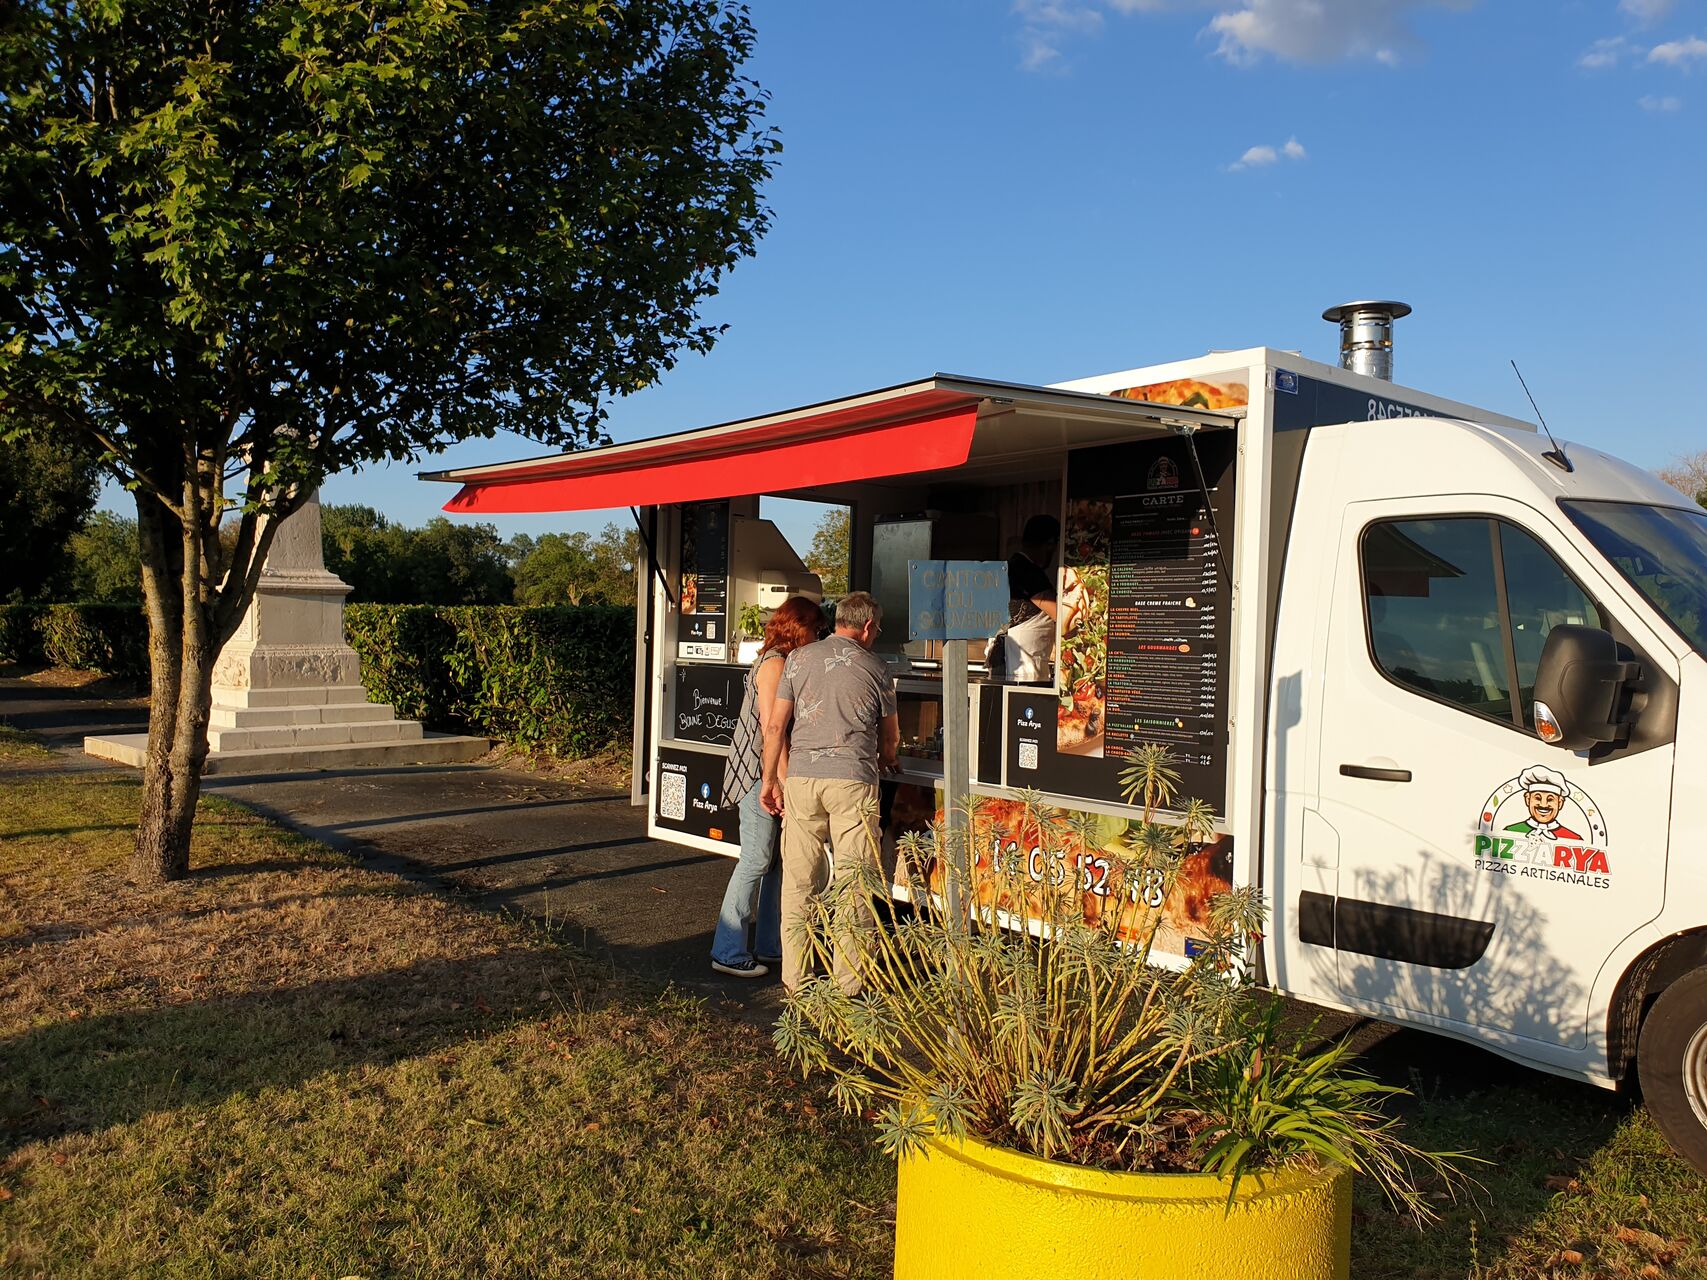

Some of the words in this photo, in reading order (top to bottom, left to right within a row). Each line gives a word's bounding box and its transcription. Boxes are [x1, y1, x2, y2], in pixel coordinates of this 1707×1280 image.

[1142, 495, 1184, 506] CARTE
[923, 570, 1000, 590] CANTON
[946, 592, 973, 608] DU
[920, 610, 1002, 630] SOUVENIR
[706, 712, 738, 730] DEGUS
[1028, 720, 1041, 730] Arya
[693, 798, 703, 808] Pizz
[704, 801, 718, 813] Arya
[1077, 854, 1112, 896] 52
[1474, 860, 1517, 874] PIZZAS
[1520, 867, 1610, 889] ARTISANALES
